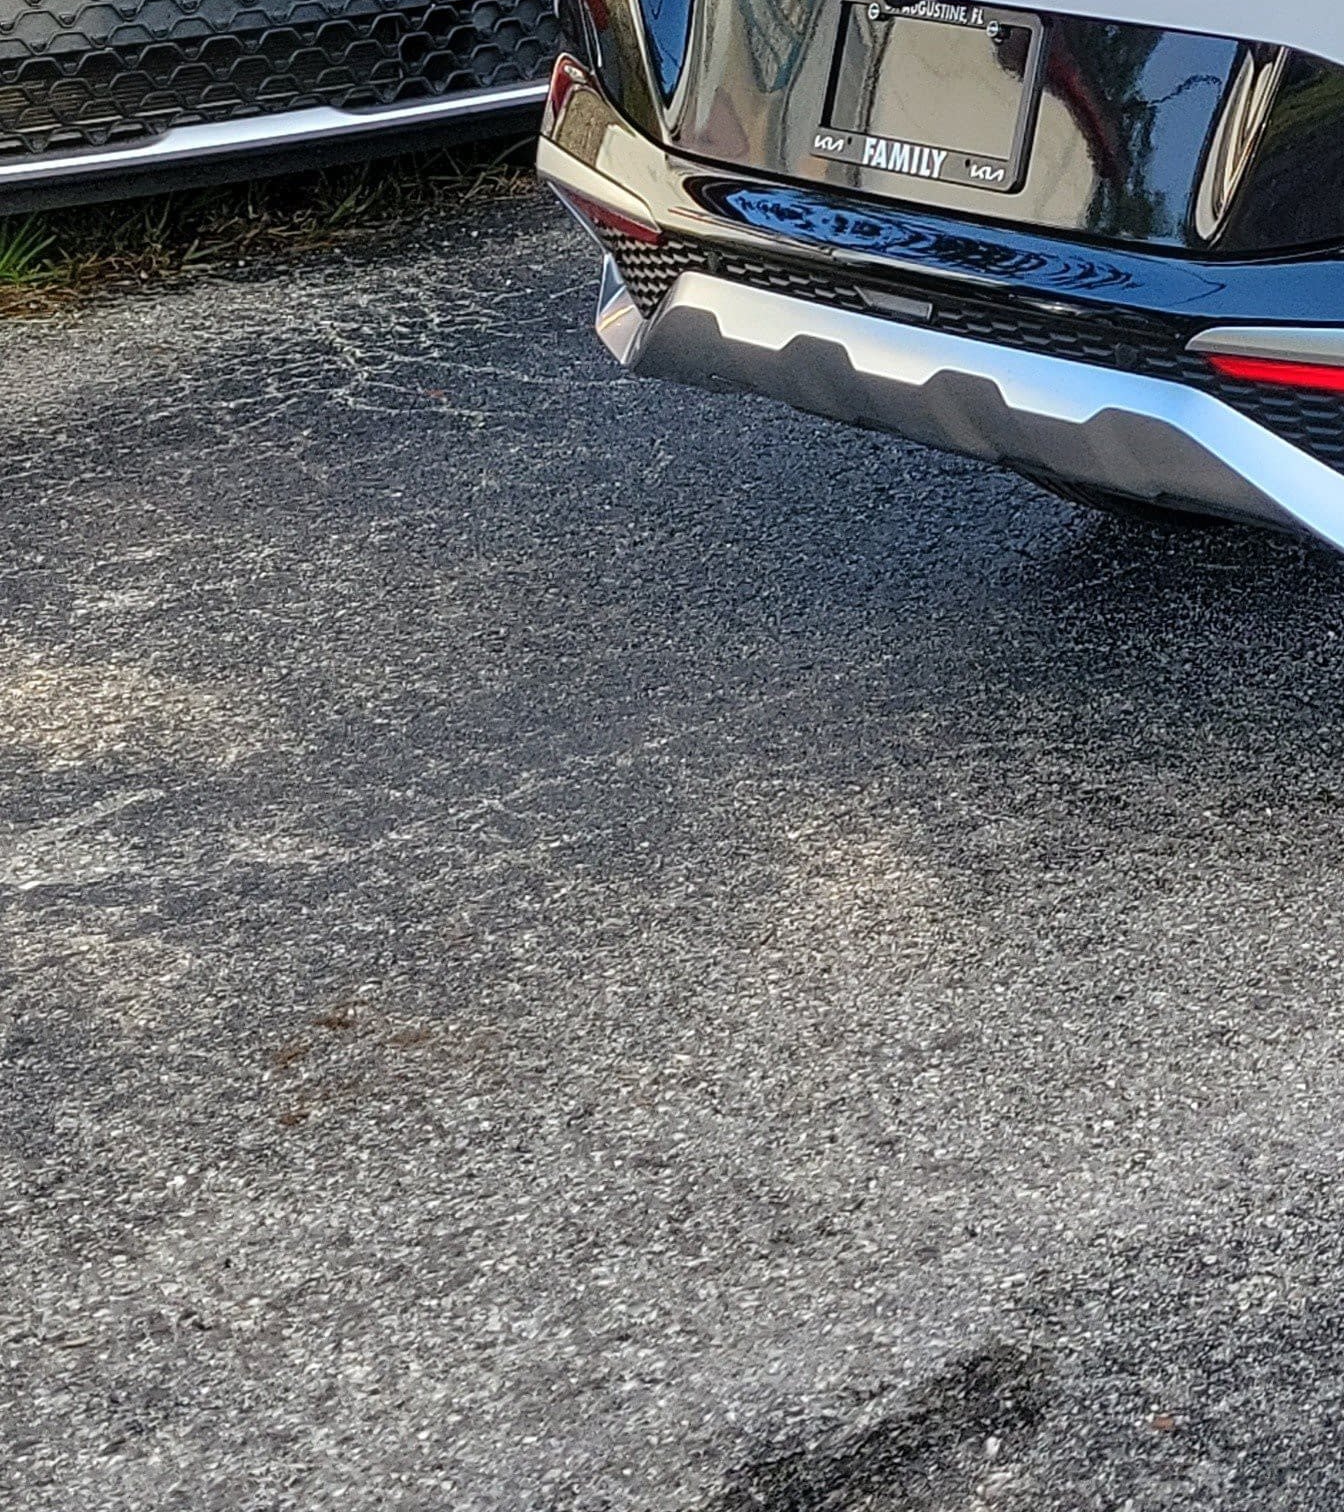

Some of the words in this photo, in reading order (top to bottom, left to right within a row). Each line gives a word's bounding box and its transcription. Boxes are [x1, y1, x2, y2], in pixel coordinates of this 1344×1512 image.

[970, 7, 985, 25] FL
[814, 135, 844, 152] KIA
[862, 137, 947, 178] FAMILY
[968, 164, 1005, 182] KIA
